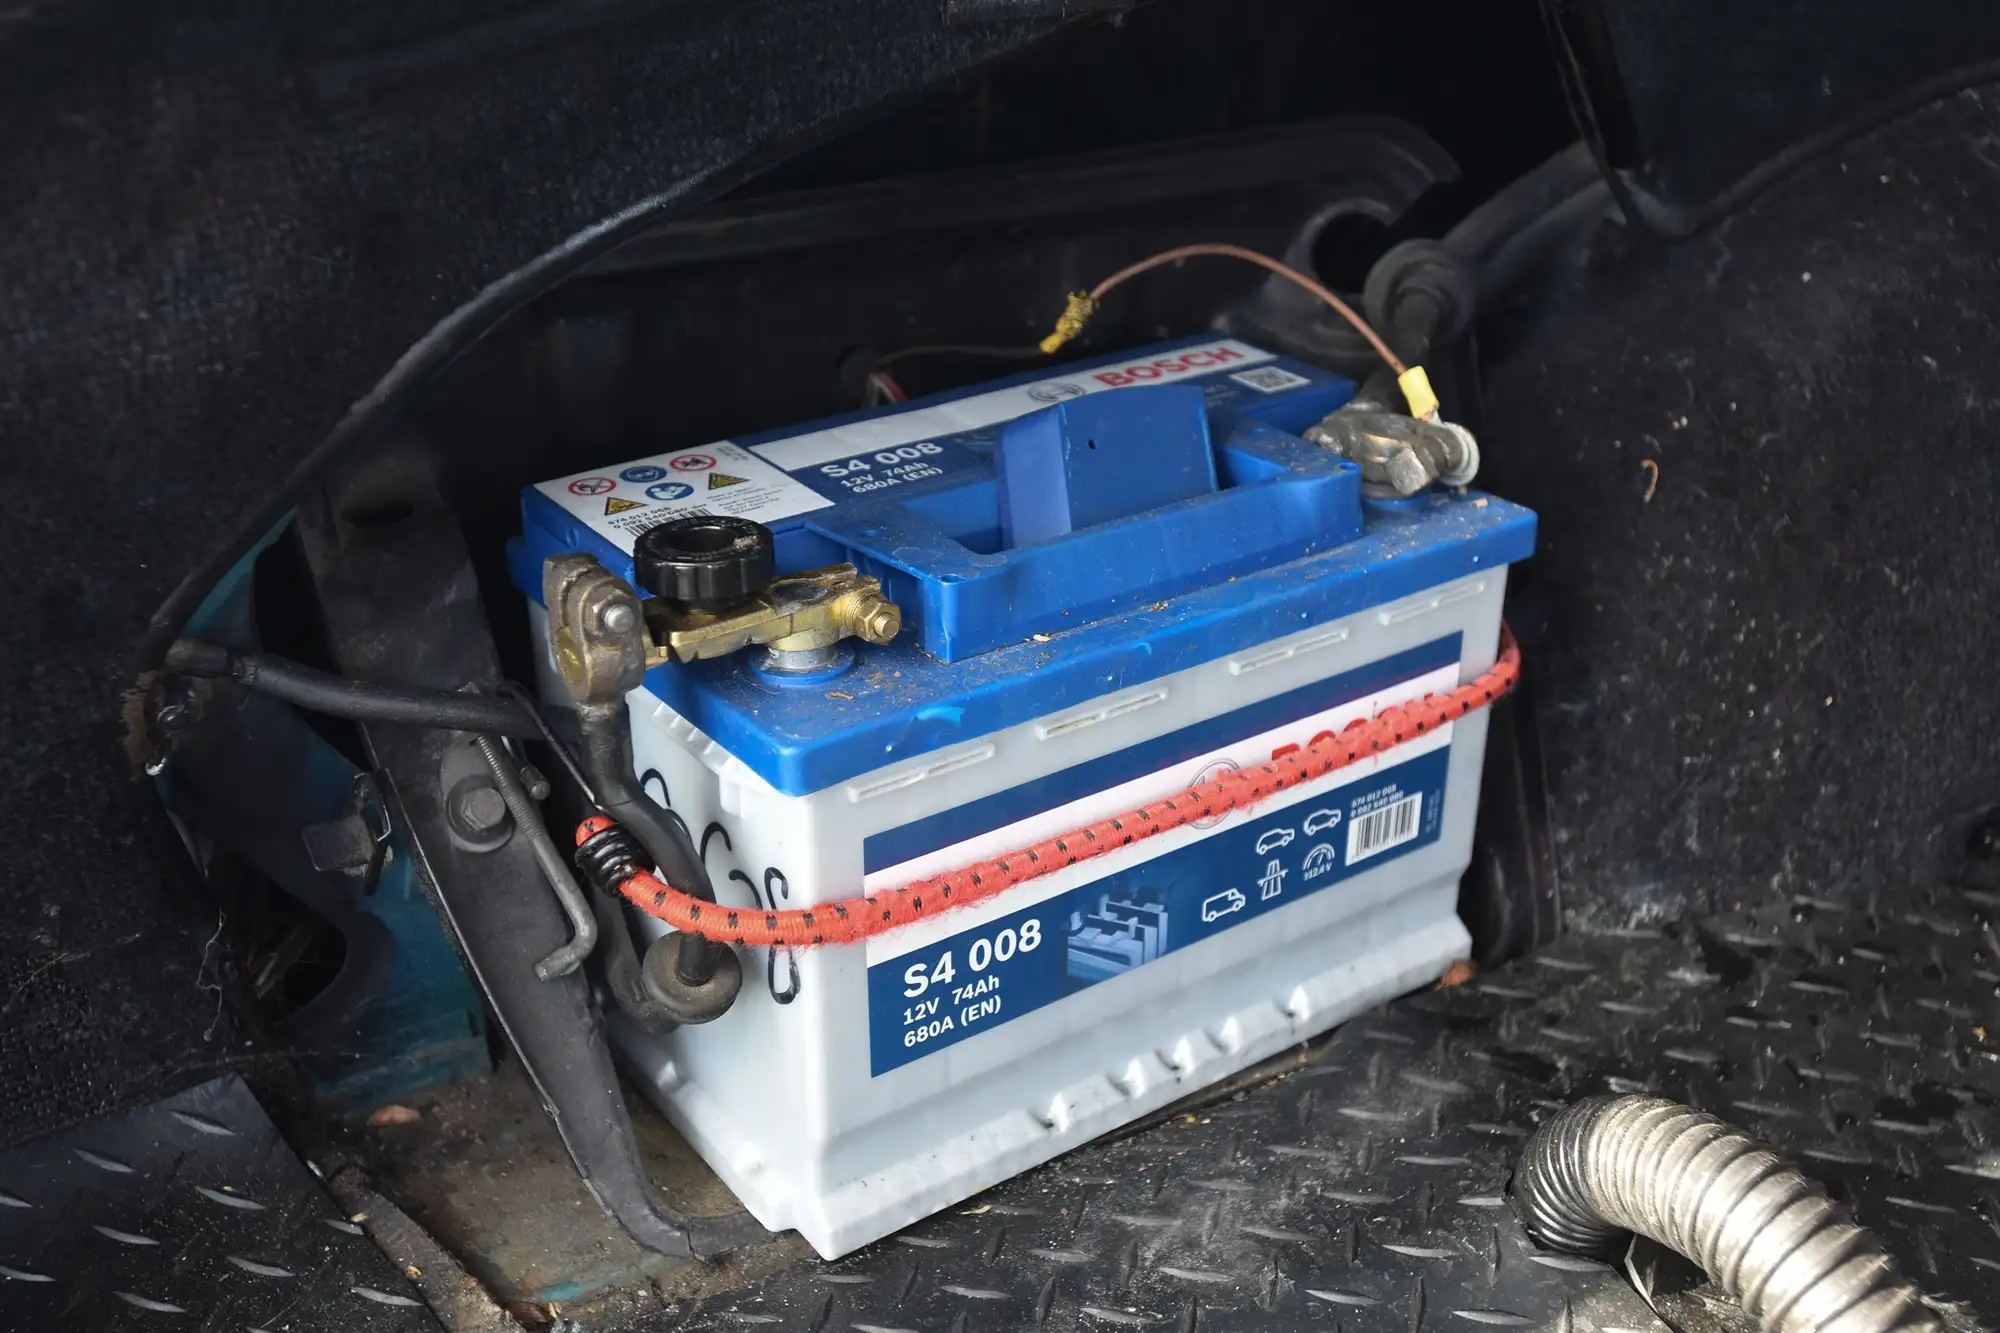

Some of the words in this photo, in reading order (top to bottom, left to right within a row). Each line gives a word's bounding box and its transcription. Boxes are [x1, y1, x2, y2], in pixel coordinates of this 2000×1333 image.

[1093, 346, 1244, 388] BOSCH
[820, 459, 871, 478] S4
[874, 442, 943, 465] 008
[840, 474, 874, 488] 12V
[882, 462, 929, 478] 74Ah
[853, 478, 900, 493] 680A
[903, 467, 943, 482] (EN)
[903, 950, 956, 998] S4
[968, 918, 1042, 972] 008
[903, 997, 940, 1026] 12V
[952, 975, 1000, 1005] 74Ah
[903, 1015, 955, 1048] 680A
[960, 994, 1002, 1027] (EN)
